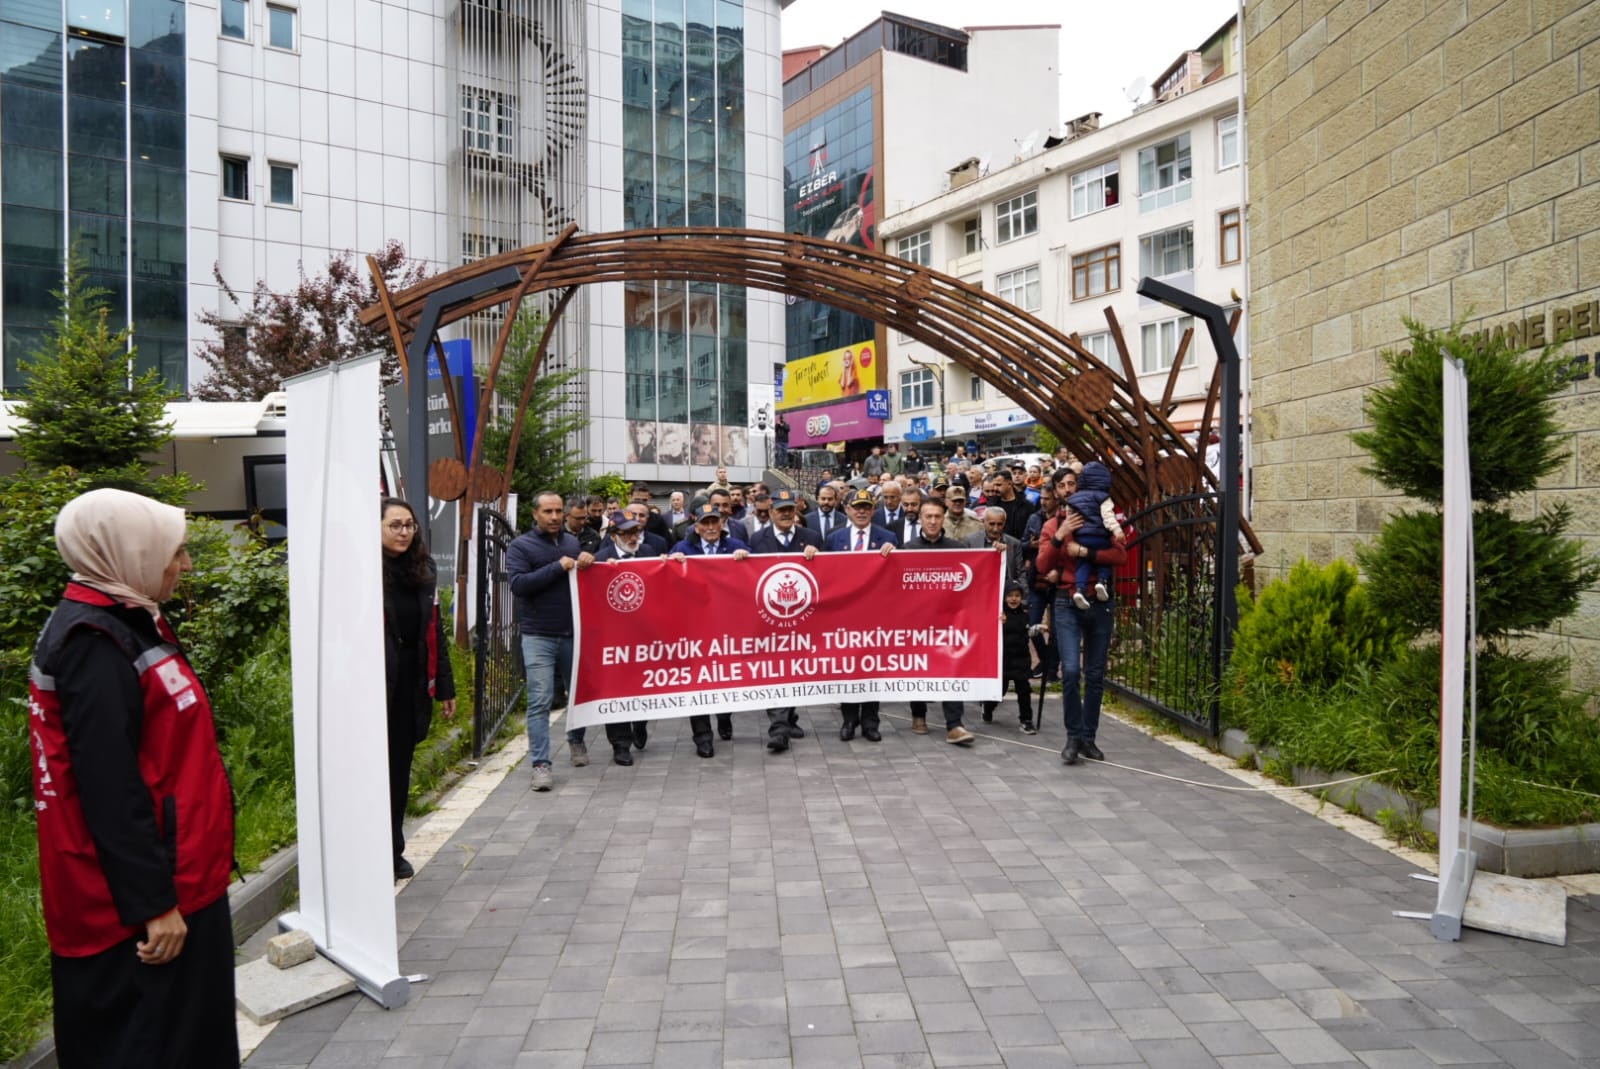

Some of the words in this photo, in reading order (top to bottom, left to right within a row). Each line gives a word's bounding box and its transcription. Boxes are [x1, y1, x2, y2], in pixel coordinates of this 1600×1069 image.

[799, 171, 837, 198] EZBER
[869, 398, 888, 413] kral
[428, 418, 452, 435] arkı
[902, 571, 964, 584] GÜMÜŞHANE
[757, 608, 775, 626] 2025
[602, 645, 630, 666] EN
[635, 637, 703, 664] BÜYÜK
[708, 631, 817, 657] AİLEMİZİN,
[642, 667, 692, 689] 2025
[697, 661, 743, 683] AİLE
[747, 659, 785, 680] YILI
[791, 656, 856, 676] KUTLU
[860, 653, 928, 673] OLSUN
[598, 694, 686, 715] GÜMÜŞHANE
[689, 692, 721, 707] AİLE
[721, 690, 740, 704] VE
[742, 686, 790, 702] SOSYAL
[792, 681, 866, 698] HİZMETLER
[868, 679, 881, 694] İL
[884, 679, 971, 694] MÜDÜRLÜĞÜ
